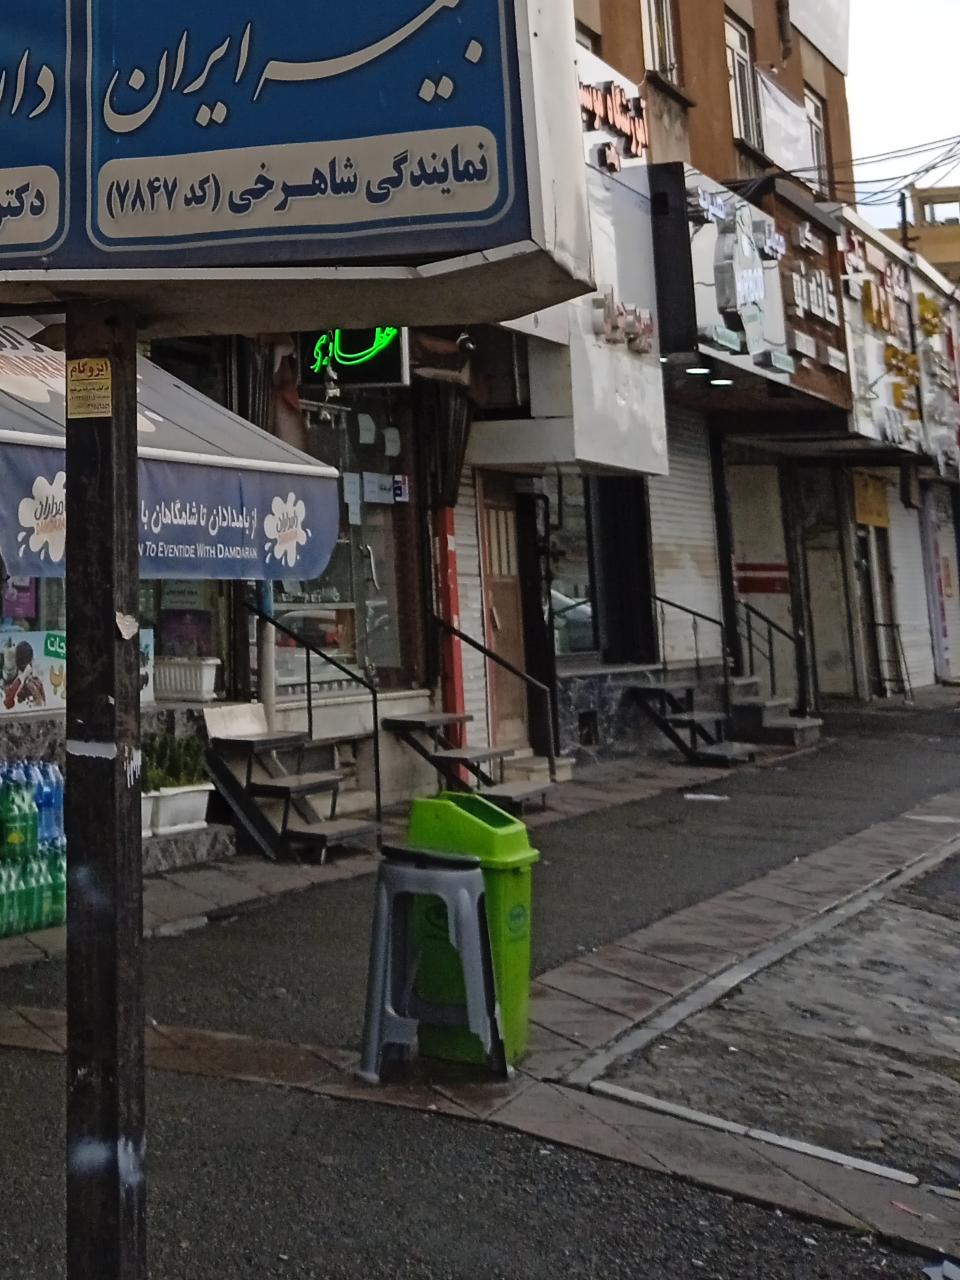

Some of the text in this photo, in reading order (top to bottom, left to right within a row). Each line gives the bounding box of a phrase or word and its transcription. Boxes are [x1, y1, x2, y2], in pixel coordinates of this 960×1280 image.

[103, 21, 252, 133] ایران
[228, 155, 359, 215] شاهرخی
[364, 141, 489, 204] نمایندگی
[183, 172, 222, 211] (کد
[150, 498, 198, 534] شامگاهان
[199, 503, 208, 529] تا
[208, 505, 251, 536] بامدادان
[250, 507, 257, 540] از
